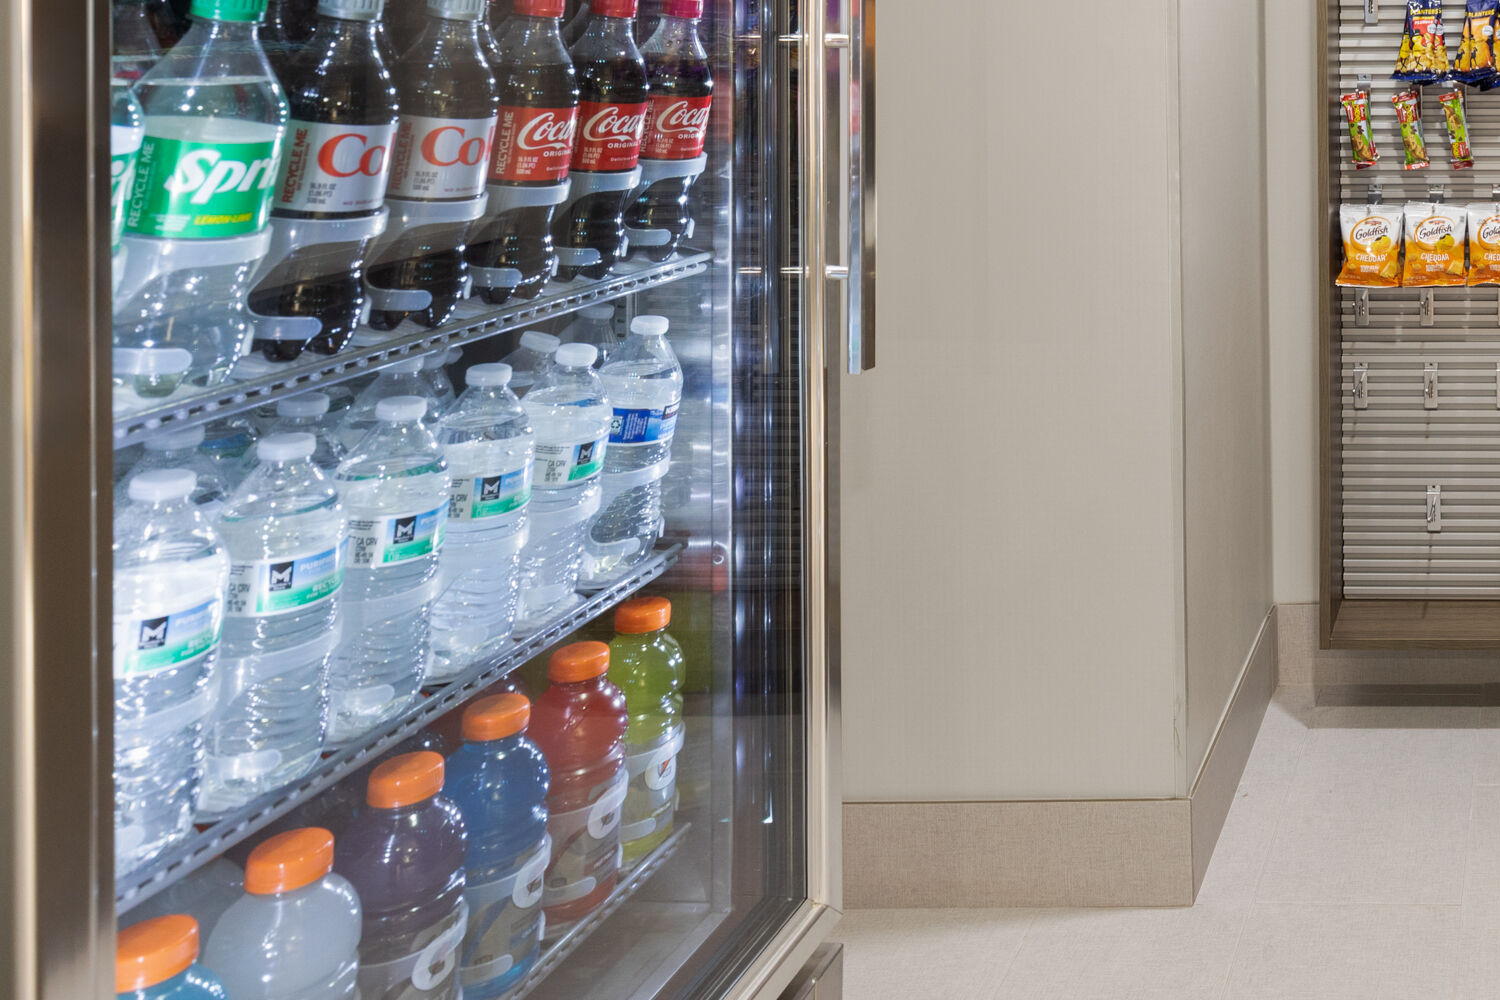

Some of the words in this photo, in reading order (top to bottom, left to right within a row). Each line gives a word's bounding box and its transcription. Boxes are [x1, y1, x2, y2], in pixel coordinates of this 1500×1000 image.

[1410, 8, 1438, 16] PLANTERS
[1468, 9, 1496, 18] PLANTERS
[502, 111, 514, 127] ME
[496, 128, 511, 174] RECYCLE
[282, 153, 300, 204] RECYCLE
[293, 128, 308, 149] ME
[127, 165, 149, 229] RECYCLE
[142, 142, 155, 163] ME
[1355, 224, 1389, 242] Goldfish
[1419, 223, 1453, 240] Goldfish
[1355, 253, 1387, 263] CHEDDAR
[1420, 252, 1450, 264] CHEDDAR
